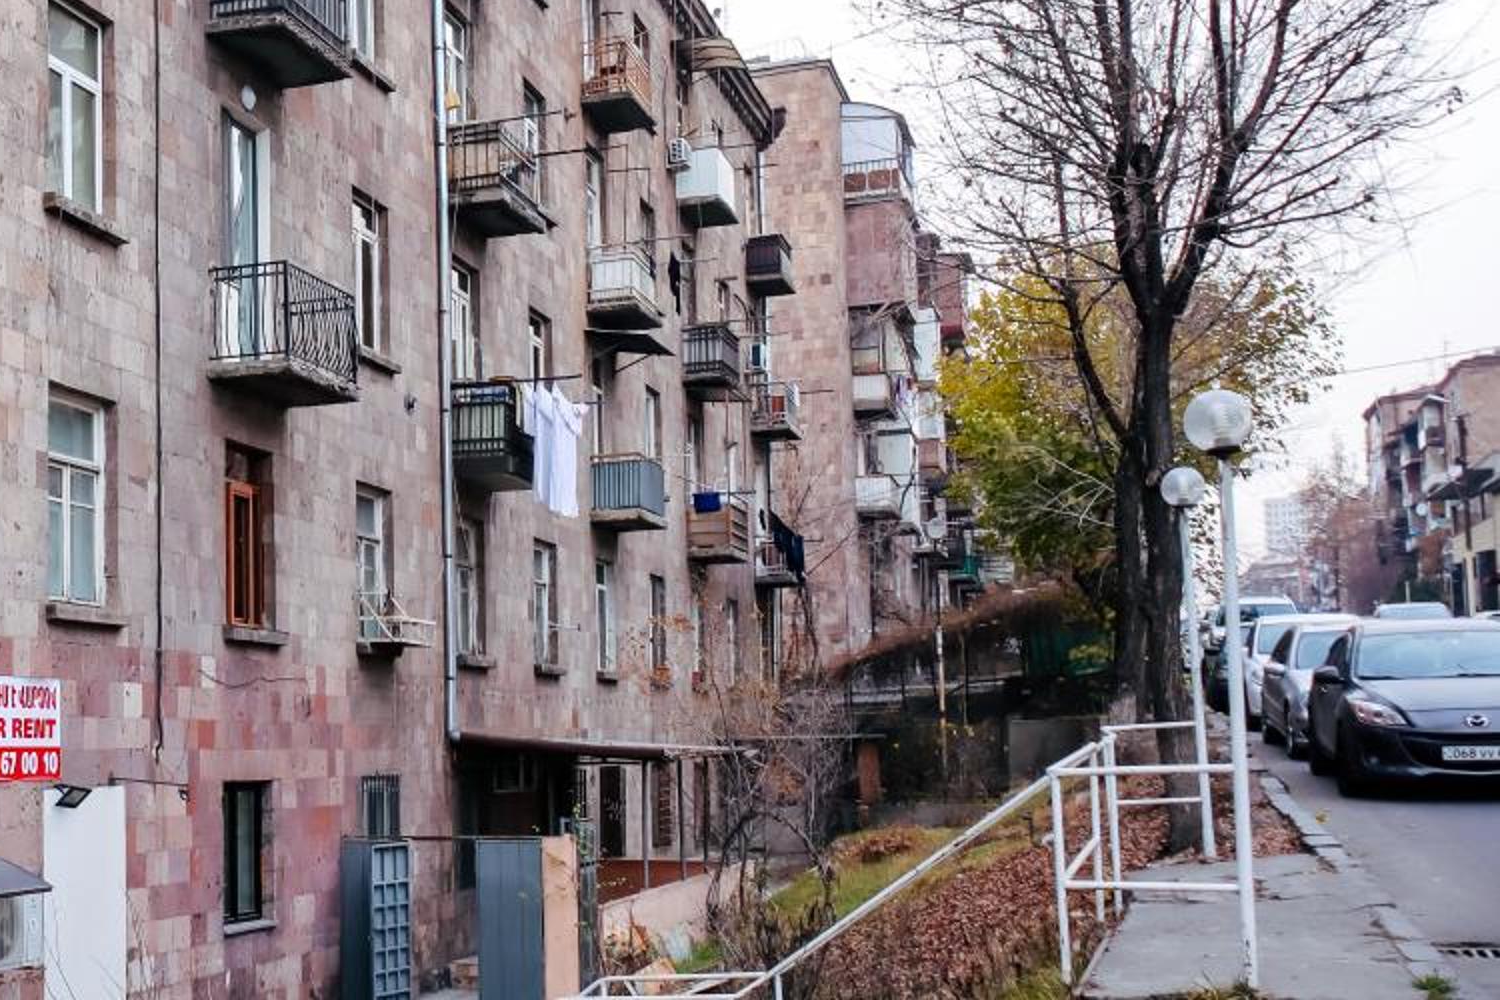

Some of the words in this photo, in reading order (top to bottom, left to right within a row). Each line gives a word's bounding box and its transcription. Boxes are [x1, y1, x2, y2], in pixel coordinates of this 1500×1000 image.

[11, 717, 57, 739] RENT
[1, 751, 18, 775] 67
[21, 751, 39, 775] 00
[43, 751, 59, 775] 10
